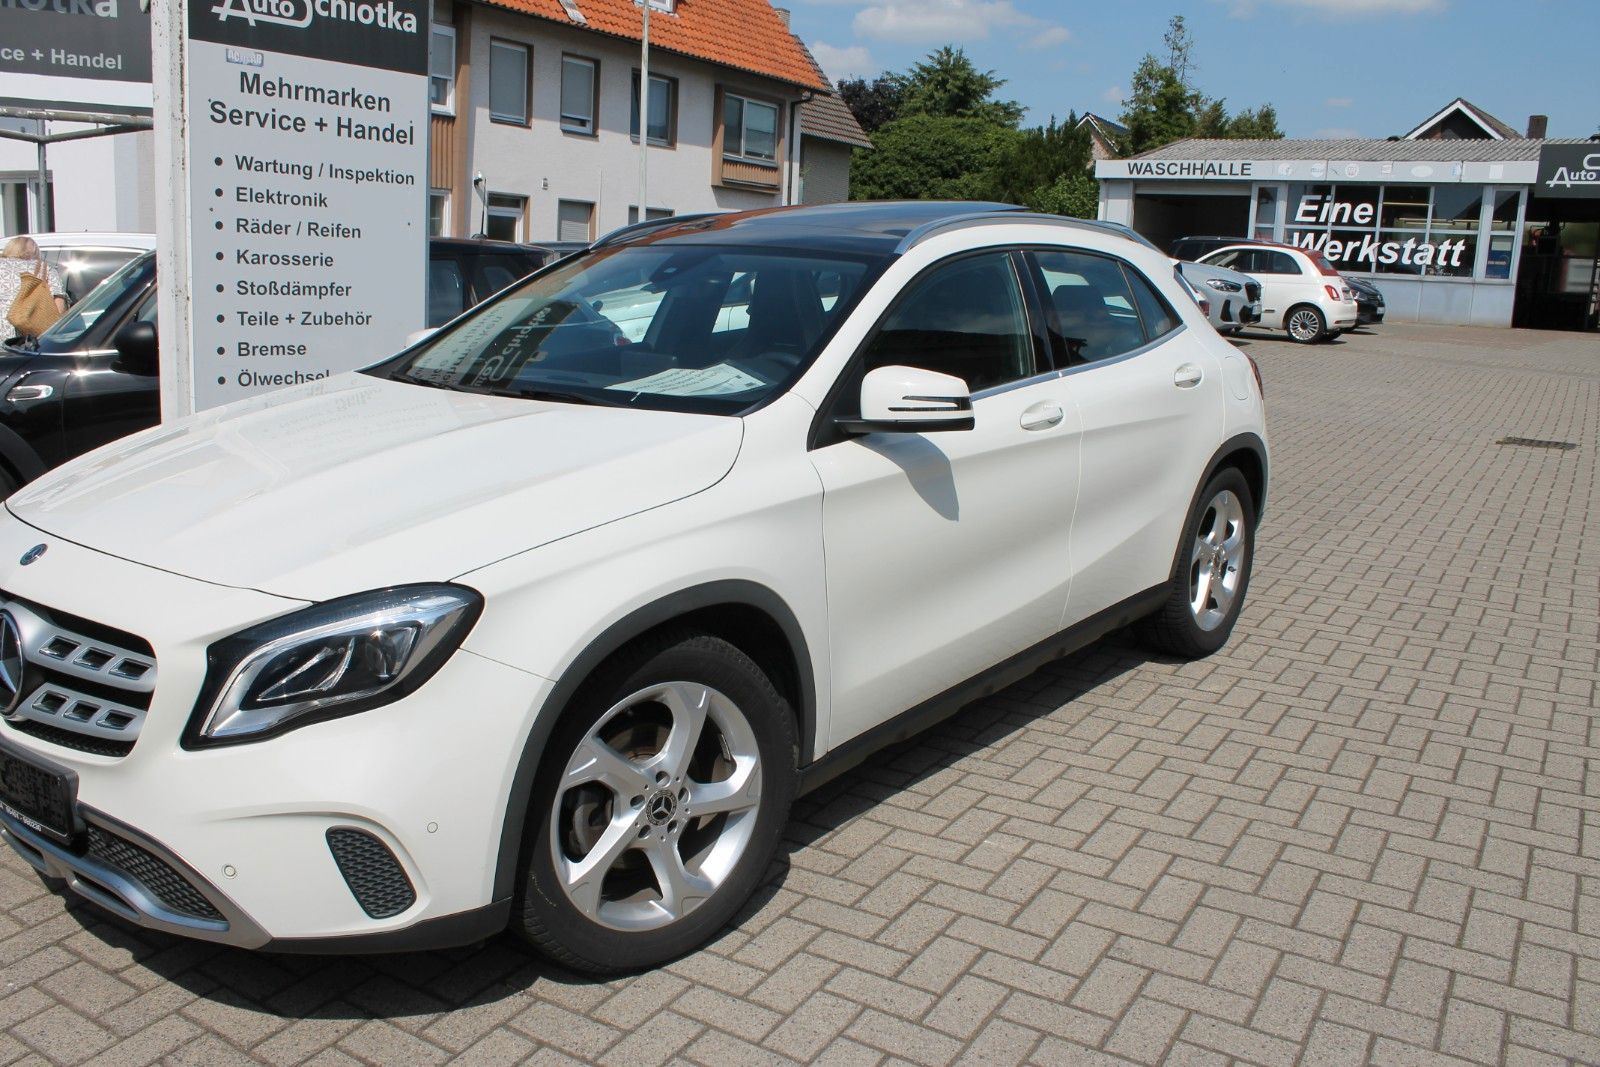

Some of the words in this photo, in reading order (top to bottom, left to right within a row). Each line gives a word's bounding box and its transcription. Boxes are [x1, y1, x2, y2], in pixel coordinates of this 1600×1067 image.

[31, 48, 44, 60] +
[51, 47, 122, 70] Handel
[240, 71, 390, 112] Mehrmarken
[210, 101, 306, 132] Service
[315, 117, 328, 131] +
[337, 116, 414, 145] Handel
[235, 154, 313, 181] Wartung
[319, 162, 324, 177] /
[329, 163, 415, 186] Inspektion
[1127, 162, 1252, 176] WASCHHALLE
[1546, 166, 1597, 188] Auto
[236, 186, 328, 208] Elektronik
[1294, 194, 1374, 224] Eine
[236, 217, 291, 236] Räder
[297, 221, 302, 236] /
[307, 221, 361, 239] Reifen
[236, 249, 334, 267] Karosserie
[1292, 231, 1466, 267] Werkstatt
[236, 280, 352, 300] Stoßdämpfer
[236, 311, 279, 326] Teile
[285, 313, 296, 325] +
[300, 310, 372, 326] Zubehör
[237, 341, 307, 357] Bremse
[237, 369, 330, 387] Ölwechsel
